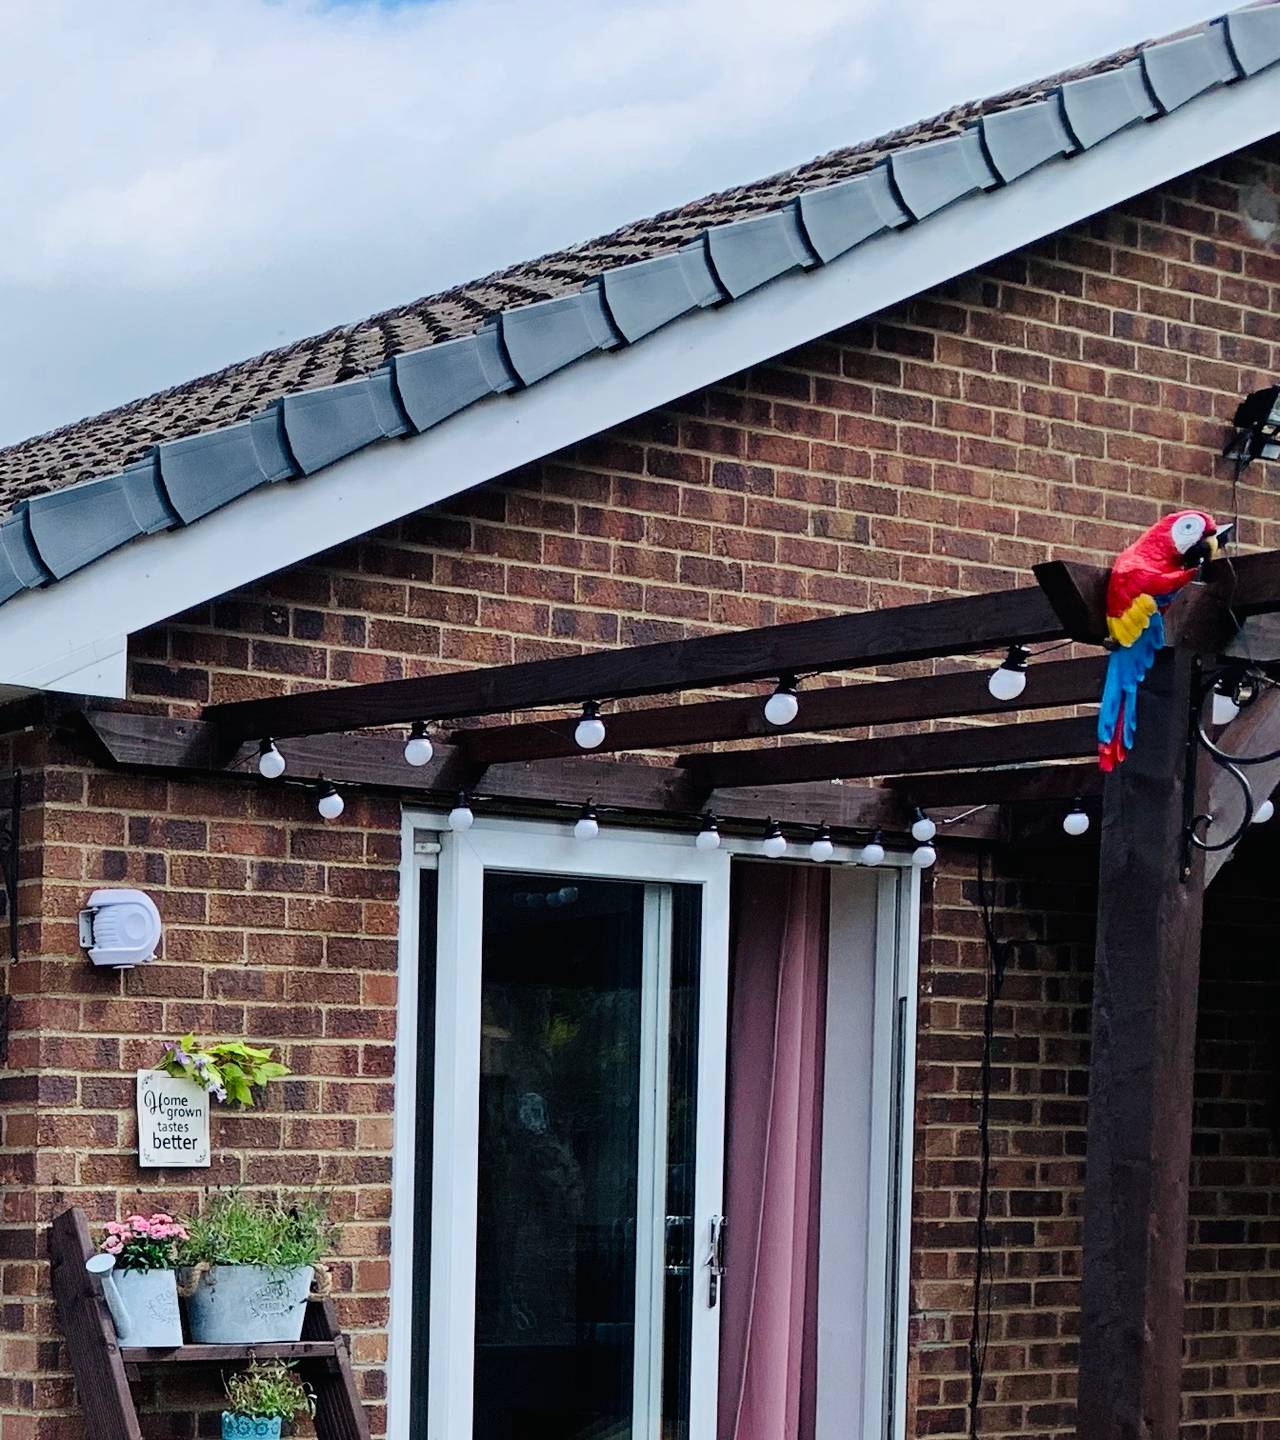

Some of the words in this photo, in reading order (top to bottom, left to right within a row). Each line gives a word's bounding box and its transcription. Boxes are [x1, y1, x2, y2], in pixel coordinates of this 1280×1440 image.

[144, 1090, 188, 1115] Home
[166, 1108, 202, 1120] grown
[157, 1122, 189, 1132] tastes
[152, 1132, 198, 1150] better
